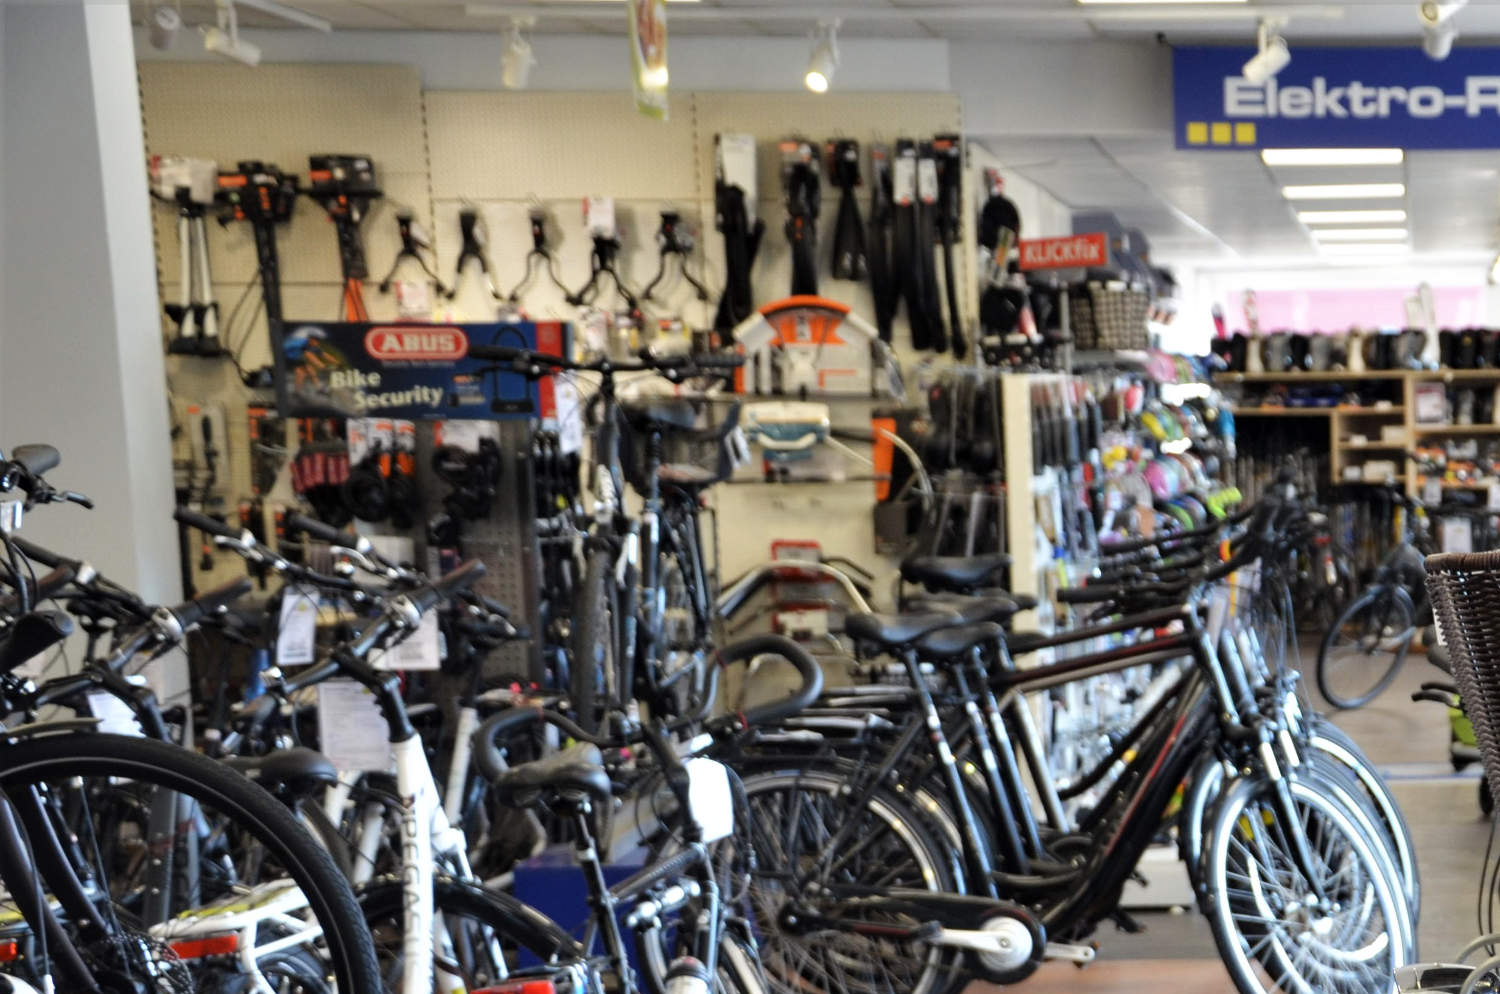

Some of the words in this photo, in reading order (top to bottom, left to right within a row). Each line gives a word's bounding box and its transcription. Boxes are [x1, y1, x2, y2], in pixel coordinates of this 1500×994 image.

[381, 332, 456, 352] ABUS
[329, 368, 381, 388] Bike
[354, 384, 444, 408] Security
